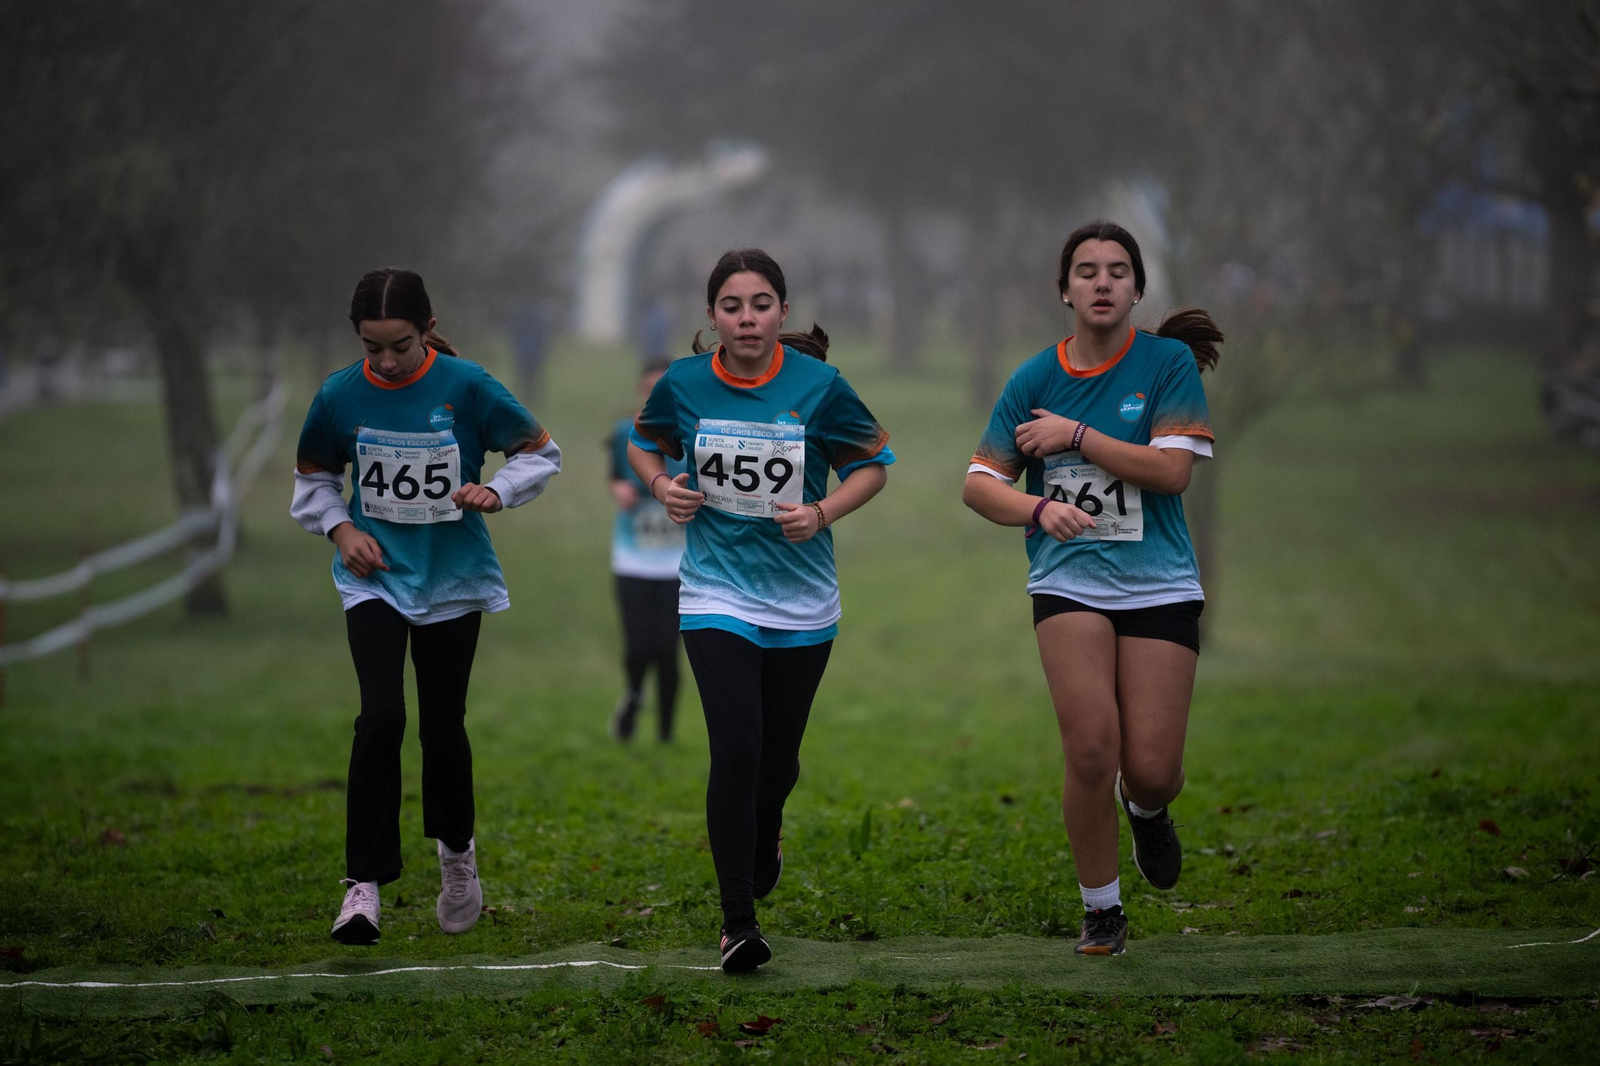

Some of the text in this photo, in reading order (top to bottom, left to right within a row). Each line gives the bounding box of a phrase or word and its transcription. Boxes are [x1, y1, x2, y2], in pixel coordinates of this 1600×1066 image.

[752, 430, 785, 438] ESCOLAR
[699, 452, 794, 494] 459
[1061, 457, 1082, 465] CROS
[361, 461, 451, 501] 465
[1050, 479, 1127, 517] 461
